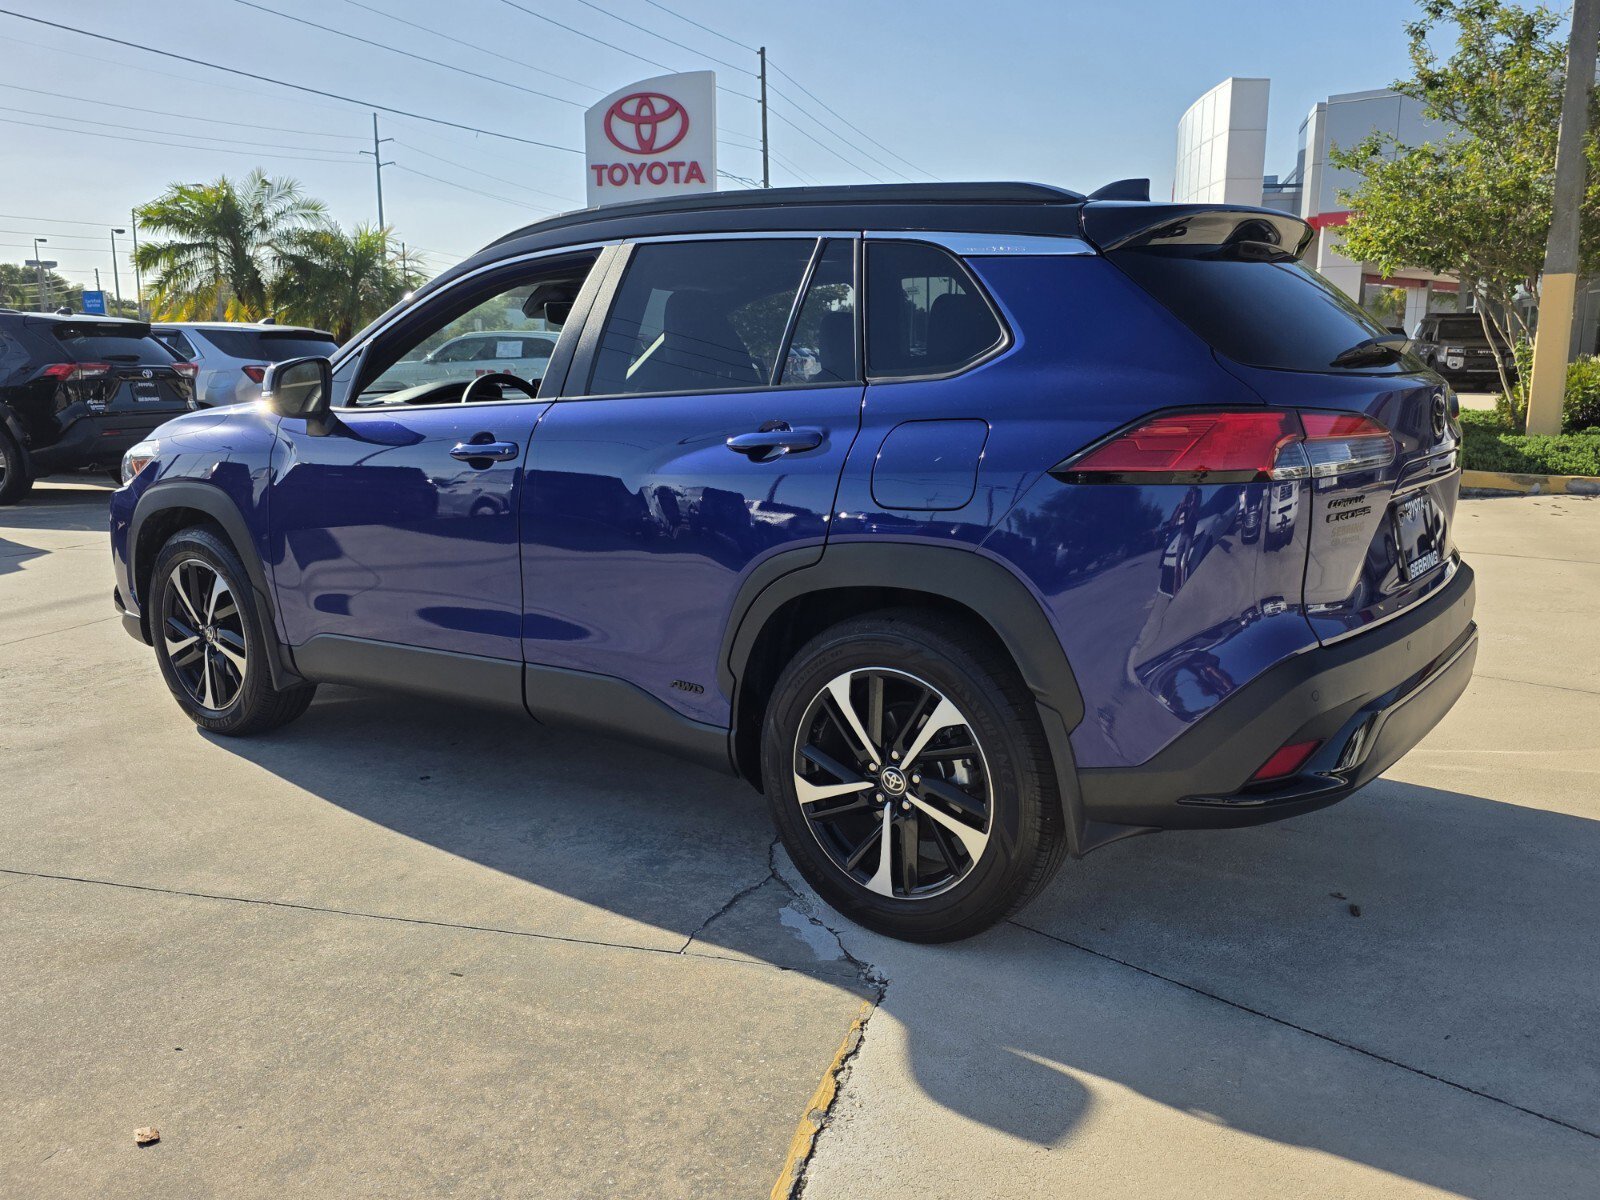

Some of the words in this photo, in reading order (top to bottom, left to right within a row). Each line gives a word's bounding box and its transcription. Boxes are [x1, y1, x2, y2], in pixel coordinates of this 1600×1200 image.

[591, 161, 706, 187] TOYOTA
[1325, 505, 1372, 523] CROSS
[1409, 550, 1439, 579] SEBRING
